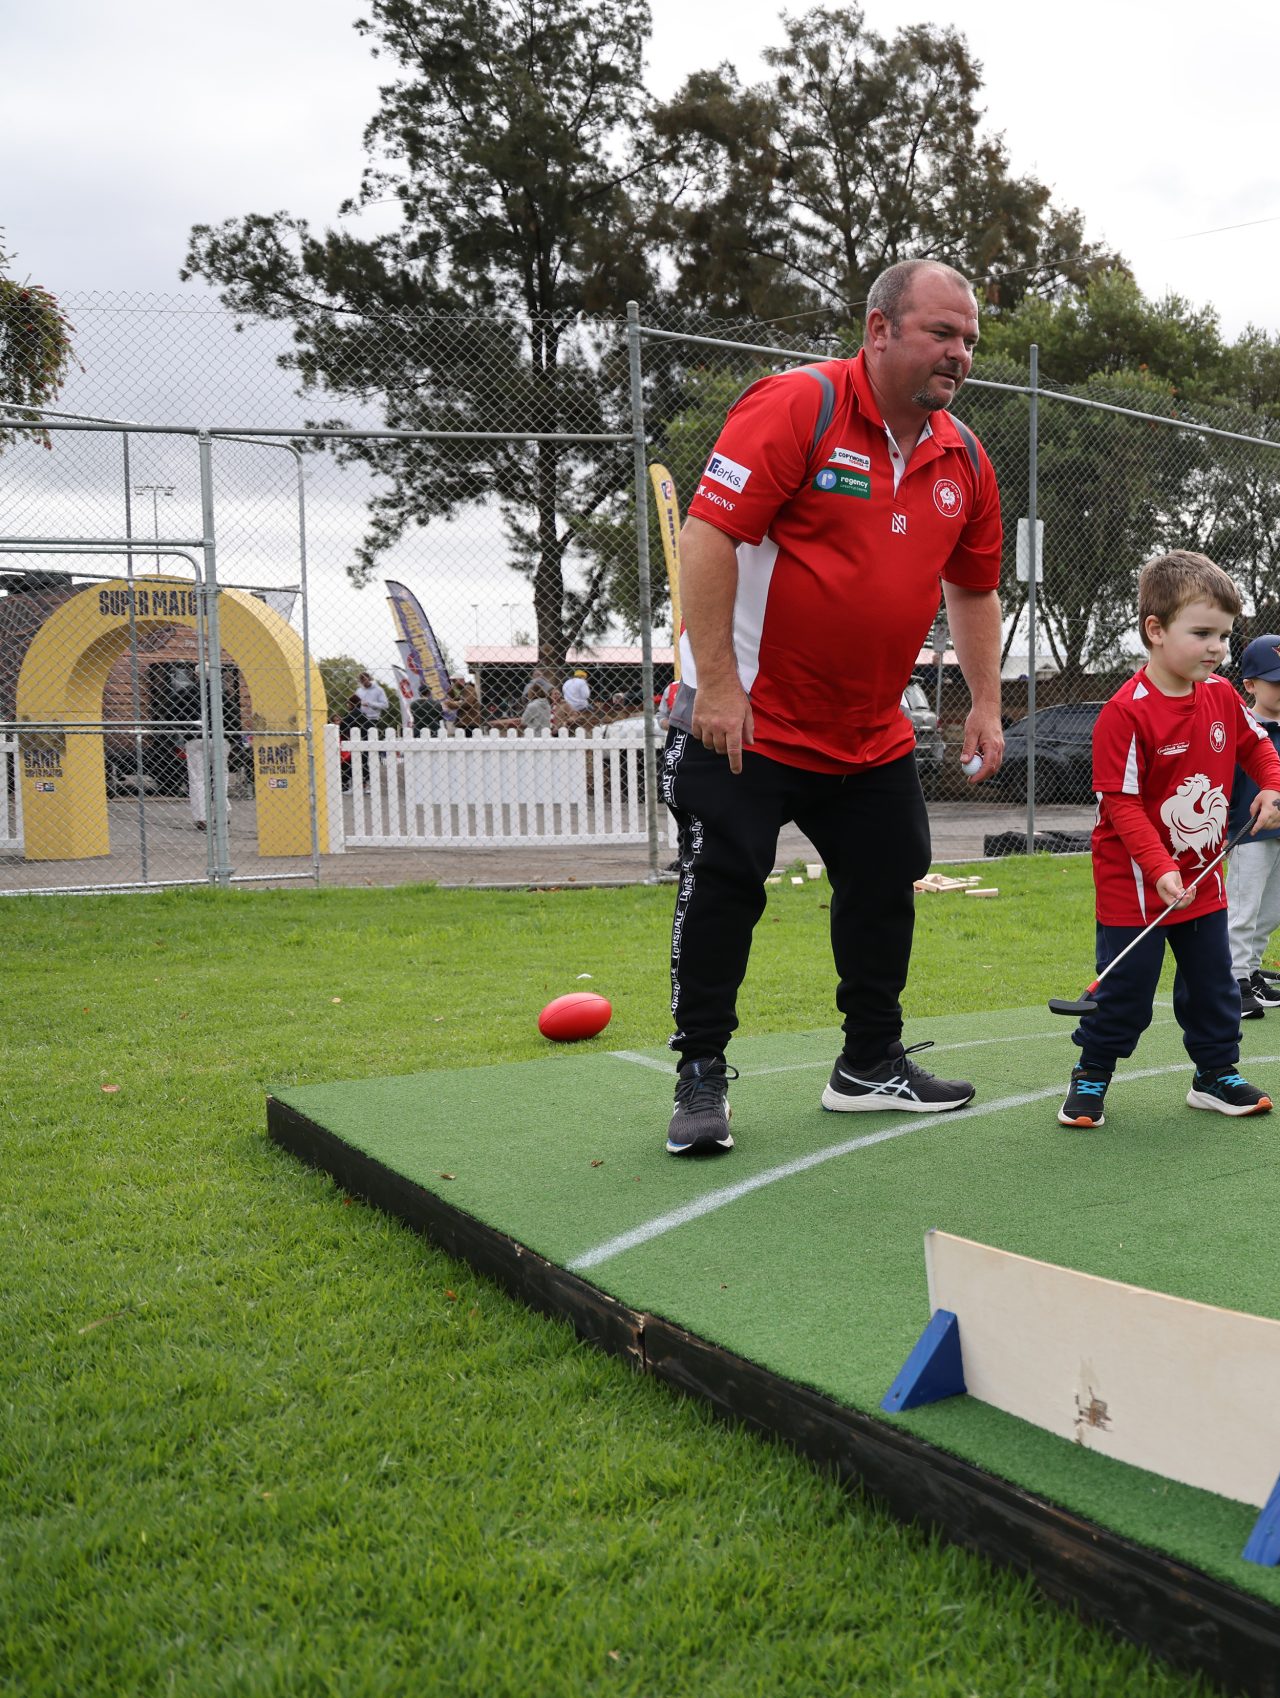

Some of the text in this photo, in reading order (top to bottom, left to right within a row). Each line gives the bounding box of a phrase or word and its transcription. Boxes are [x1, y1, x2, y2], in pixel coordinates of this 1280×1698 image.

[840, 476, 868, 489] regency
[705, 491, 736, 511] SIGNS
[672, 909, 684, 959] LONSDALE
